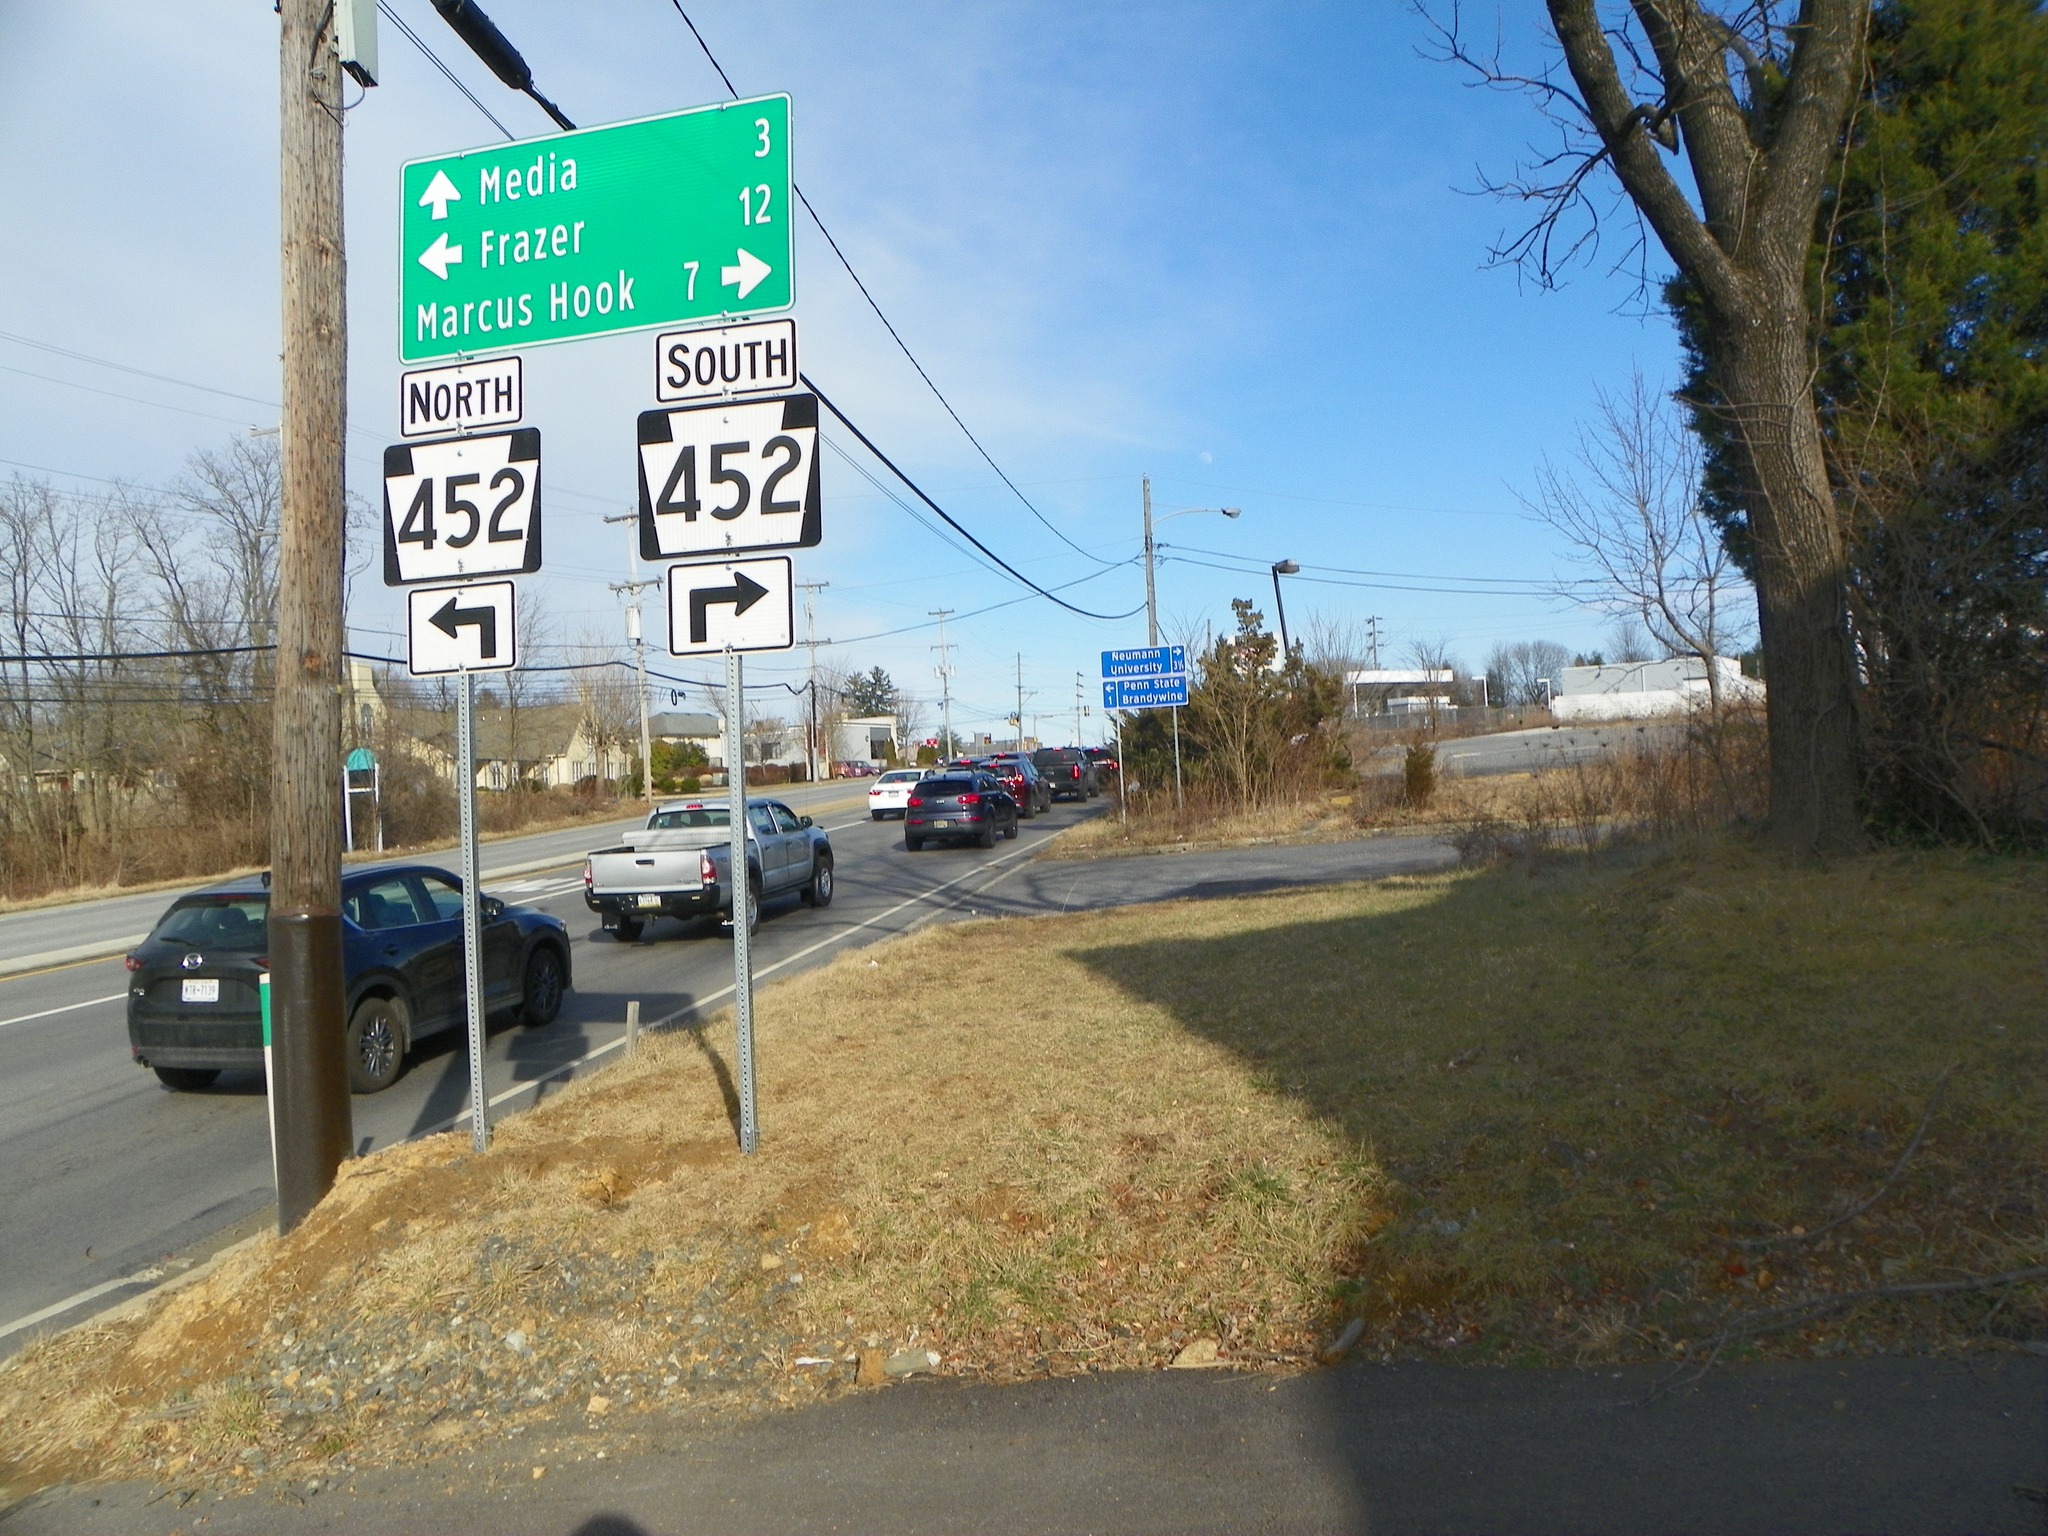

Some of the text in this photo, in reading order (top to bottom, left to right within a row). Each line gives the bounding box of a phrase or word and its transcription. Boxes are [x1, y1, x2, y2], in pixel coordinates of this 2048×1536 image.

[754, 117, 771, 158] 3
[479, 152, 578, 205] Media
[738, 183, 772, 226] 12
[480, 220, 586, 269] Frazer
[682, 260, 700, 301] 7
[416, 269, 635, 342] Marcus Hook
[666, 338, 787, 388] SOUTH
[409, 375, 513, 425] NORTH
[655, 435, 801, 522] 452
[398, 467, 524, 550] 452
[1111, 662, 1162, 676] University
[1112, 650, 1160, 661] Neumann
[1122, 691, 1183, 705] Brandywine
[1124, 678, 1180, 691] Penn State
